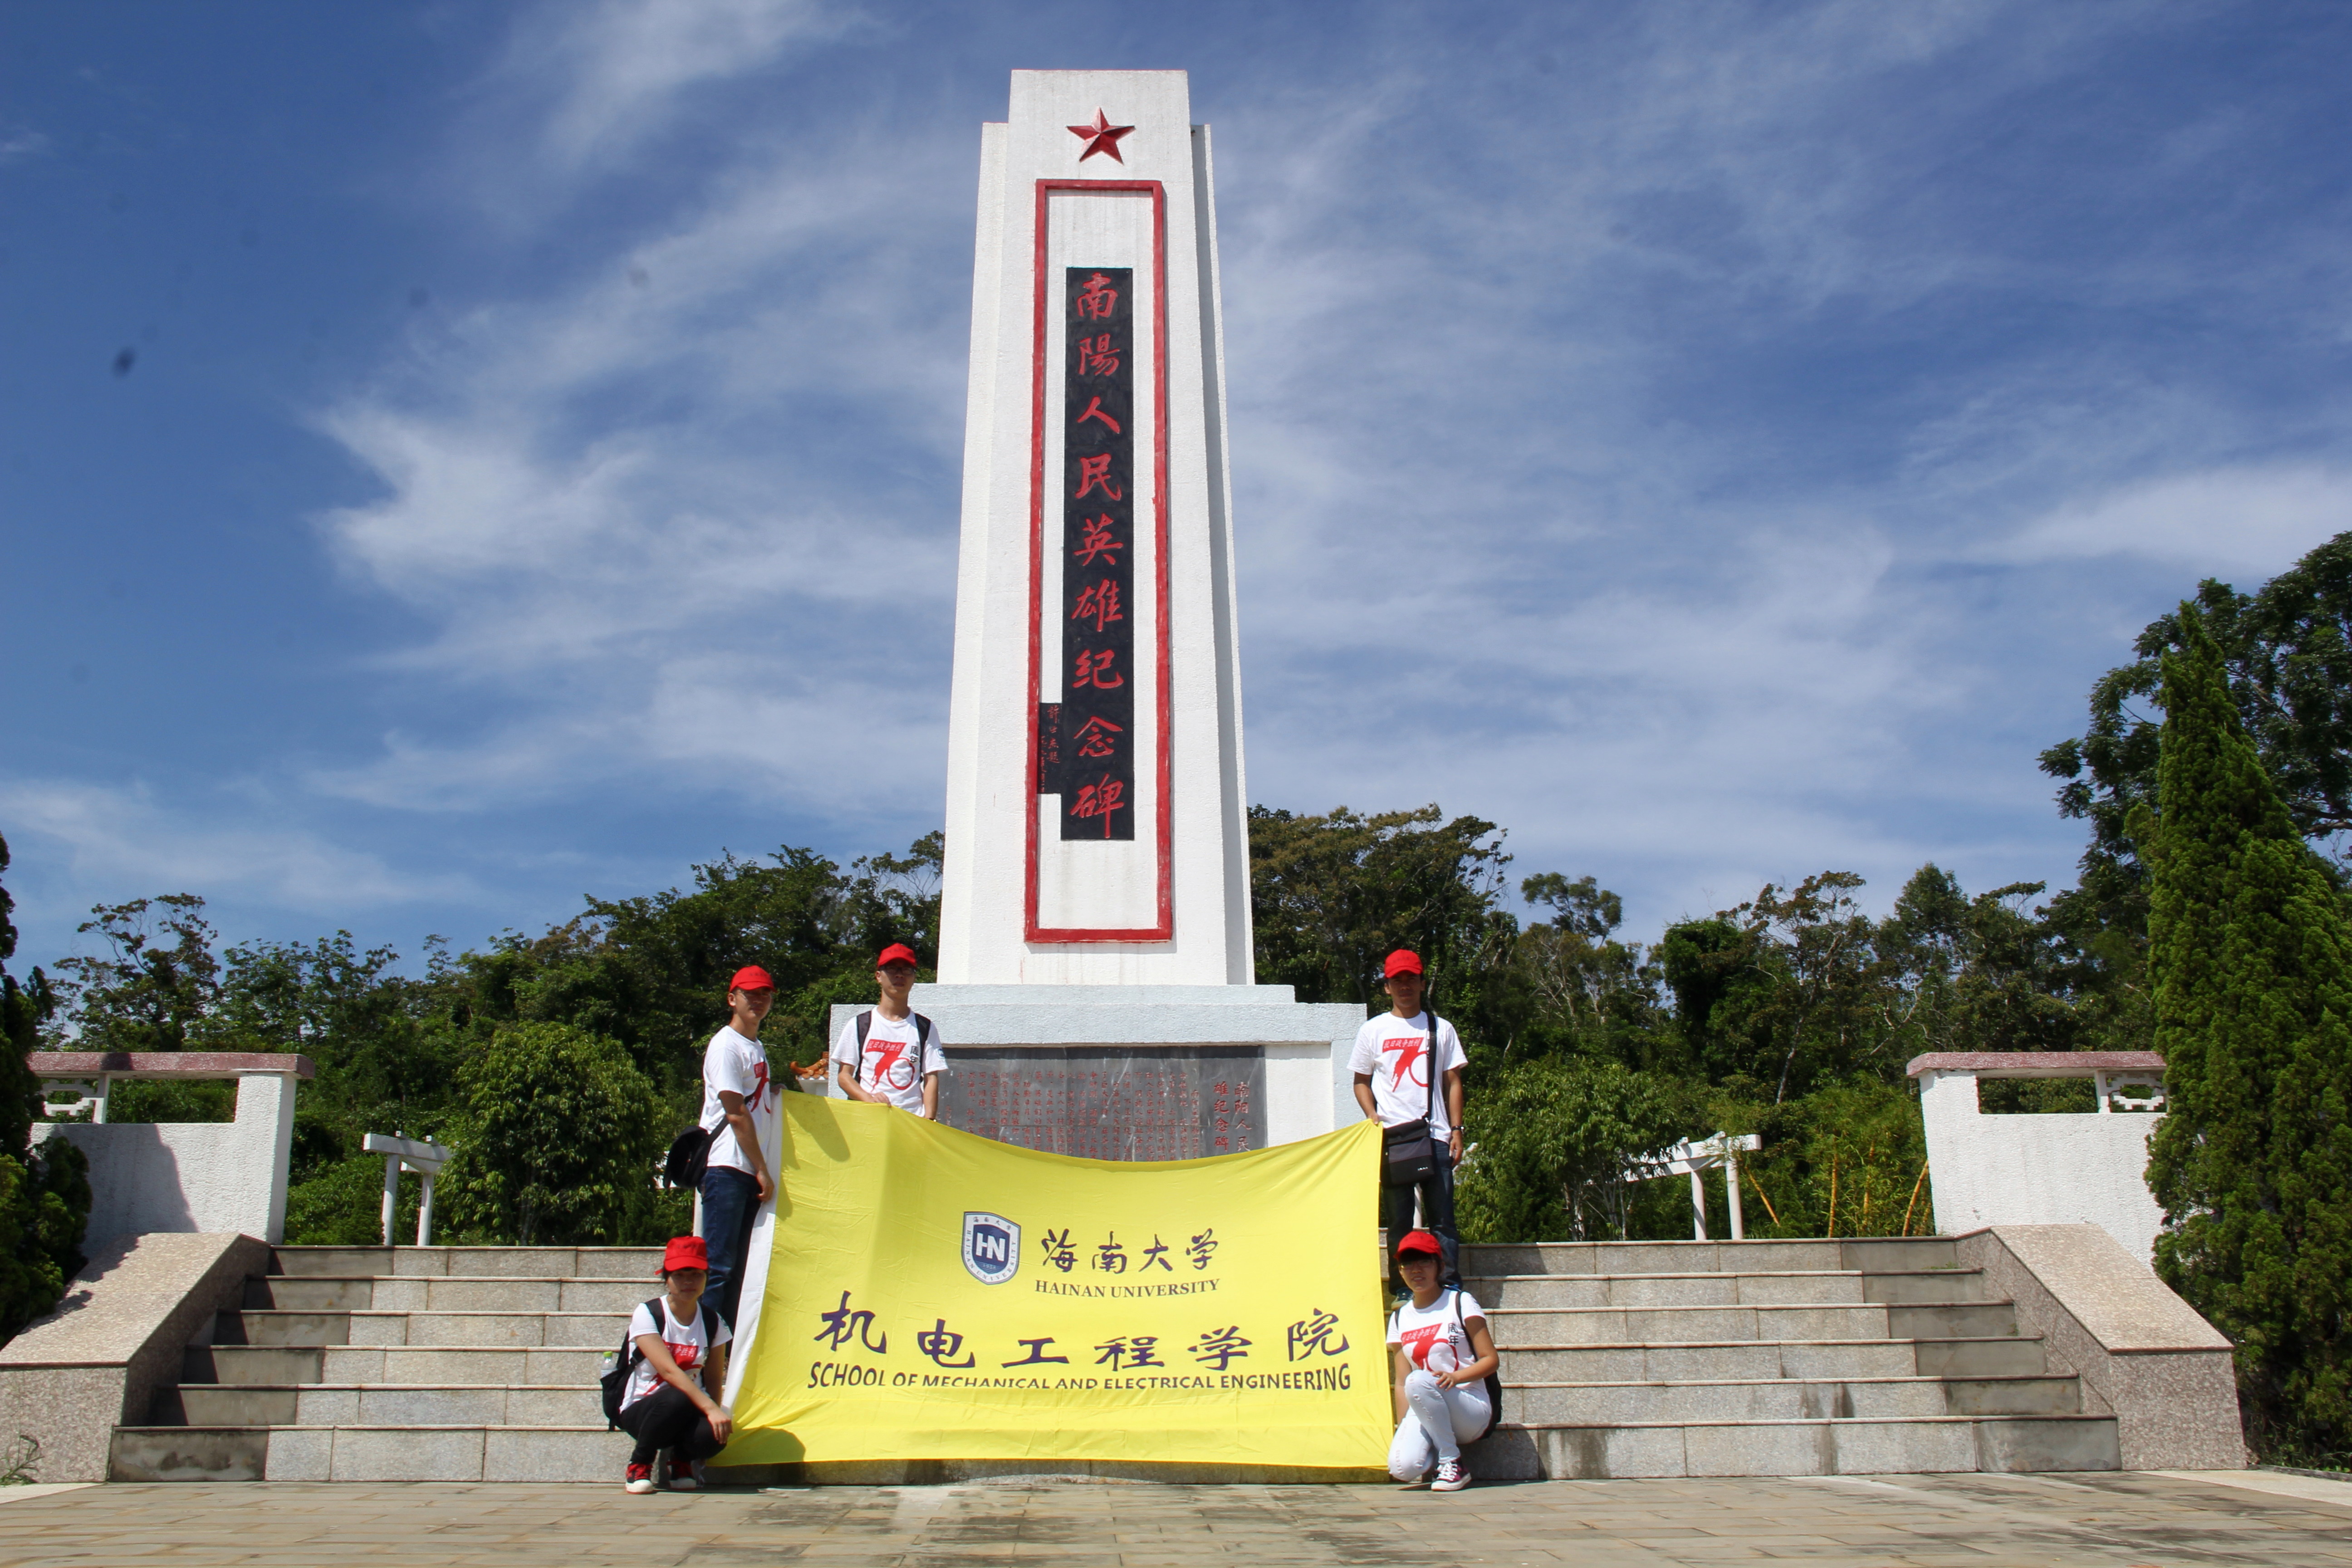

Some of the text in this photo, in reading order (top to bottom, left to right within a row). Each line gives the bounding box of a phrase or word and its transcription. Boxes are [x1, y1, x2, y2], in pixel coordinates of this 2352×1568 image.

[1213, 1081, 1230, 1152] 雄纪念碑
[973, 1216, 1013, 1230] 海南大学
[965, 1230, 1017, 1281] HAINAN UNIVERSITY
[975, 1232, 1006, 1262] HN
[1041, 1228, 1219, 1274] 海南大学
[1035, 1279, 1220, 1298] HAINAN UNIVERSITY
[813, 1291, 1350, 1372] 机电工程学院
[1448, 1323, 1459, 1346] 周年
[808, 1362, 1351, 1391] SCHOOL OF MECHANICAL AND ELECTRICAL ENGINEERING
